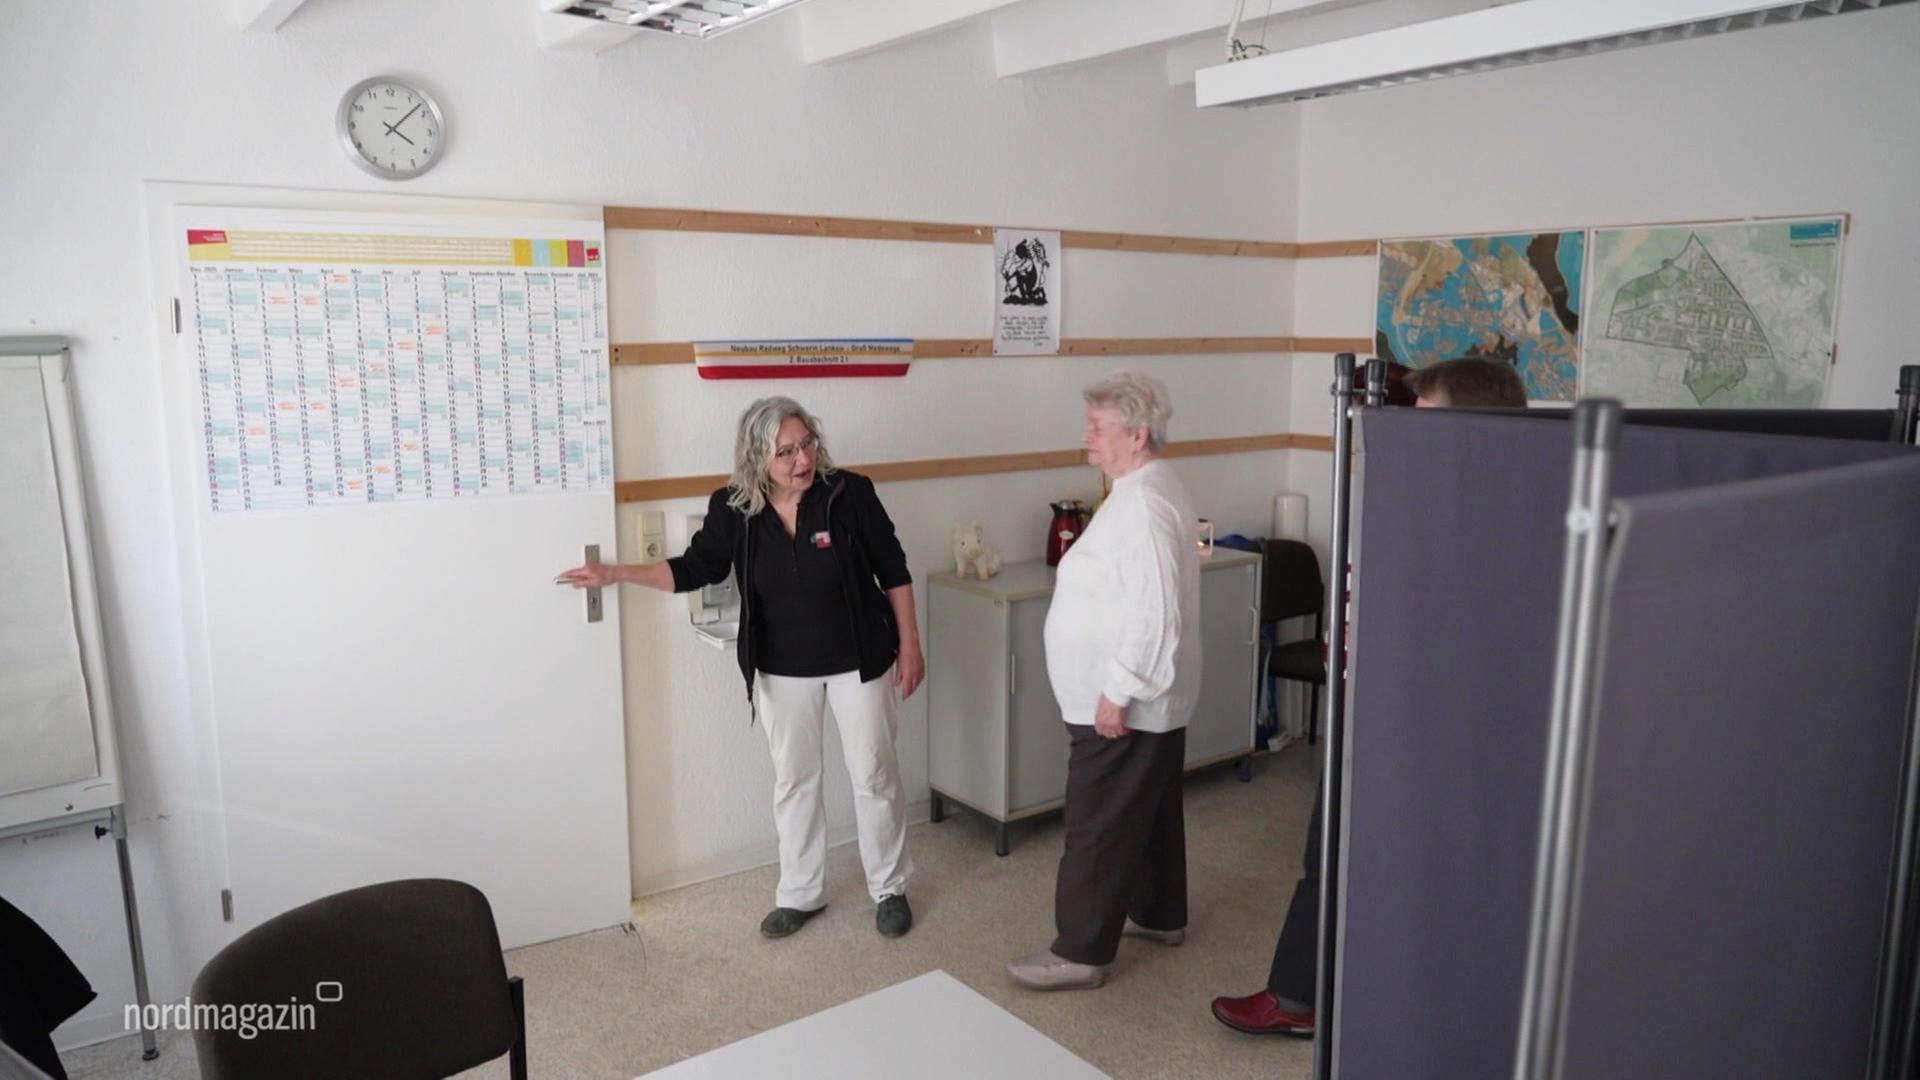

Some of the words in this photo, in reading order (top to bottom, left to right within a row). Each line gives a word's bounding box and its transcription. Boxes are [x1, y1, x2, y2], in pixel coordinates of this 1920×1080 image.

[386, 88, 396, 97] 12
[730, 344, 757, 352] Neubau
[788, 344, 818, 352] Schwerin
[819, 344, 845, 352] Lankow
[796, 355, 838, 363] Bauabschnitt
